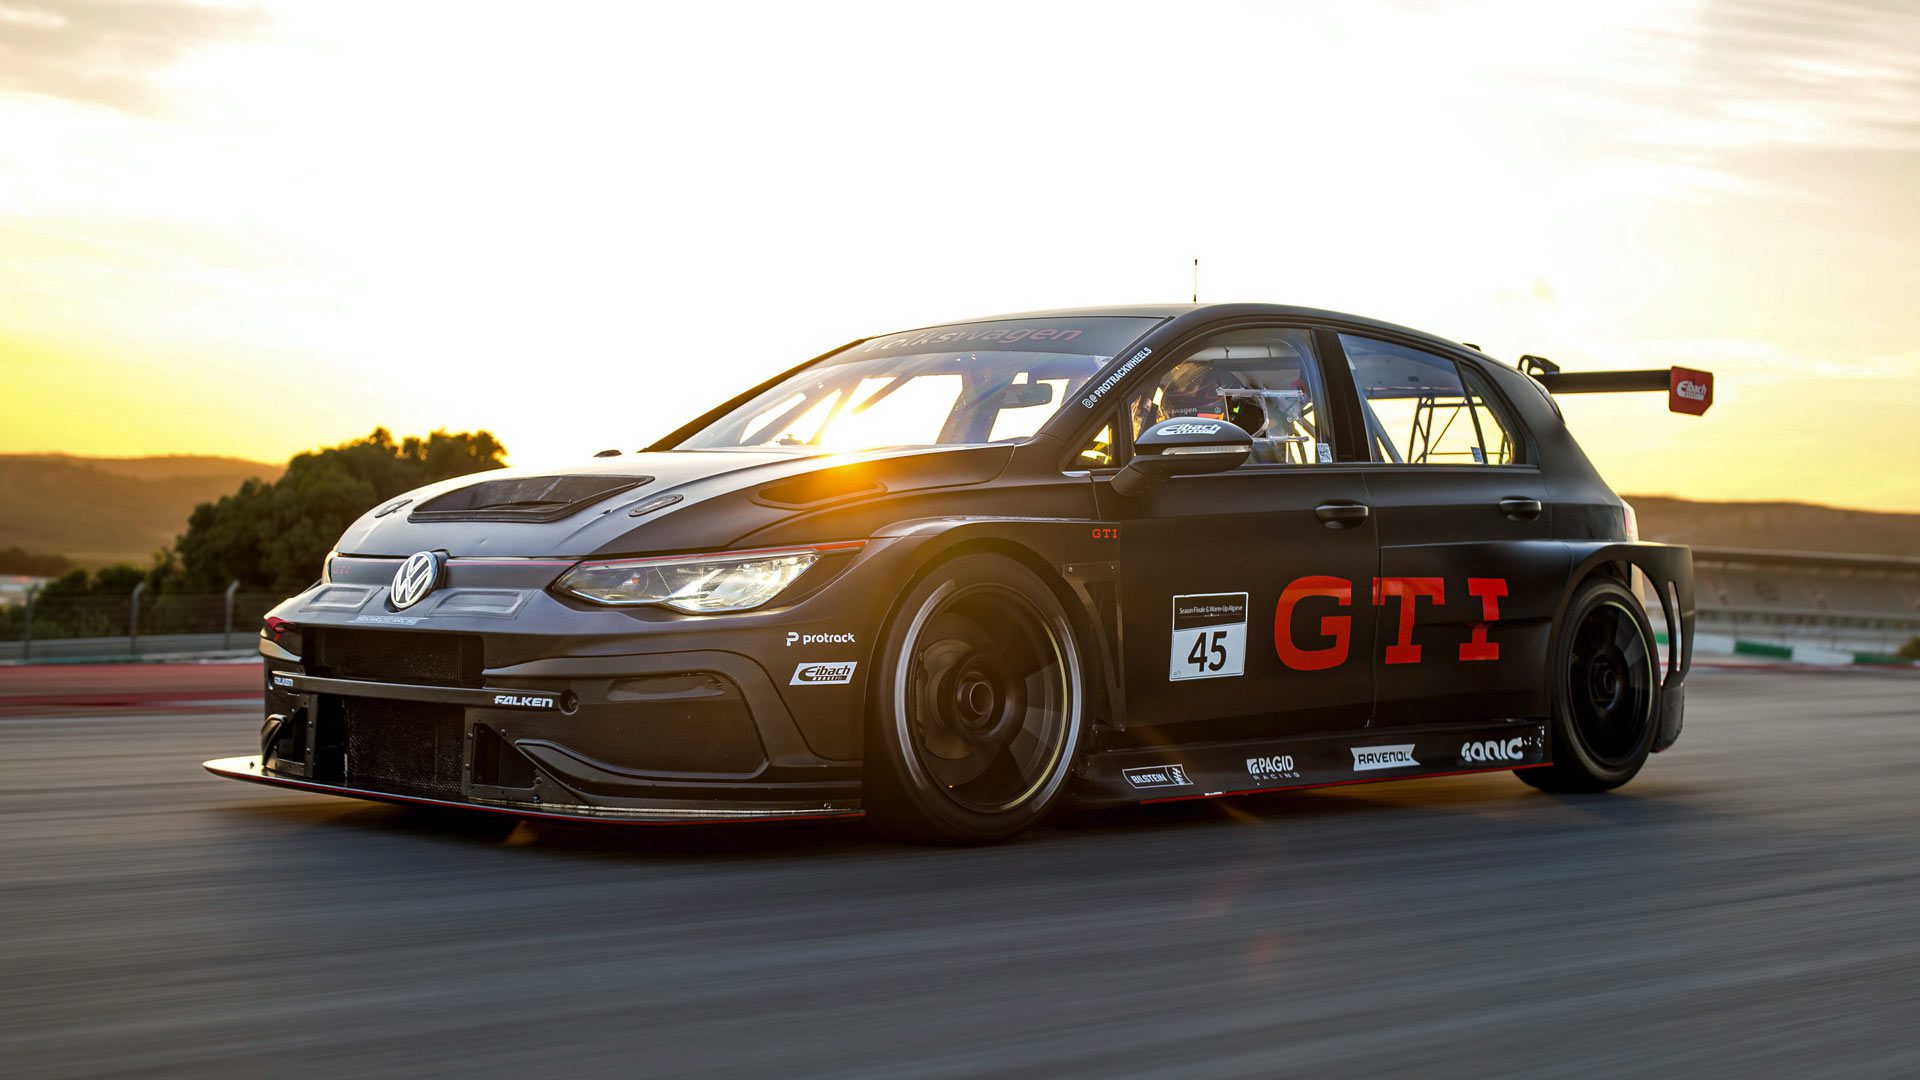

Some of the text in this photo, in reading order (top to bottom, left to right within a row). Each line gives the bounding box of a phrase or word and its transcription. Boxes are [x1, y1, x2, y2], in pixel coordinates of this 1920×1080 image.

[864, 328, 1082, 352] Volkswagen
[1092, 528, 1118, 539] GTI
[1274, 575, 1509, 671] GTI
[803, 633, 855, 645] protrack
[1187, 630, 1228, 673] 45
[798, 665, 851, 682] Eibach
[494, 695, 554, 708] FALKEN
[1258, 755, 1294, 773] PAGID
[1358, 751, 1408, 765] RAVENOL
[1131, 773, 1168, 784] BILSTEIN
[1253, 773, 1301, 781] RACING
